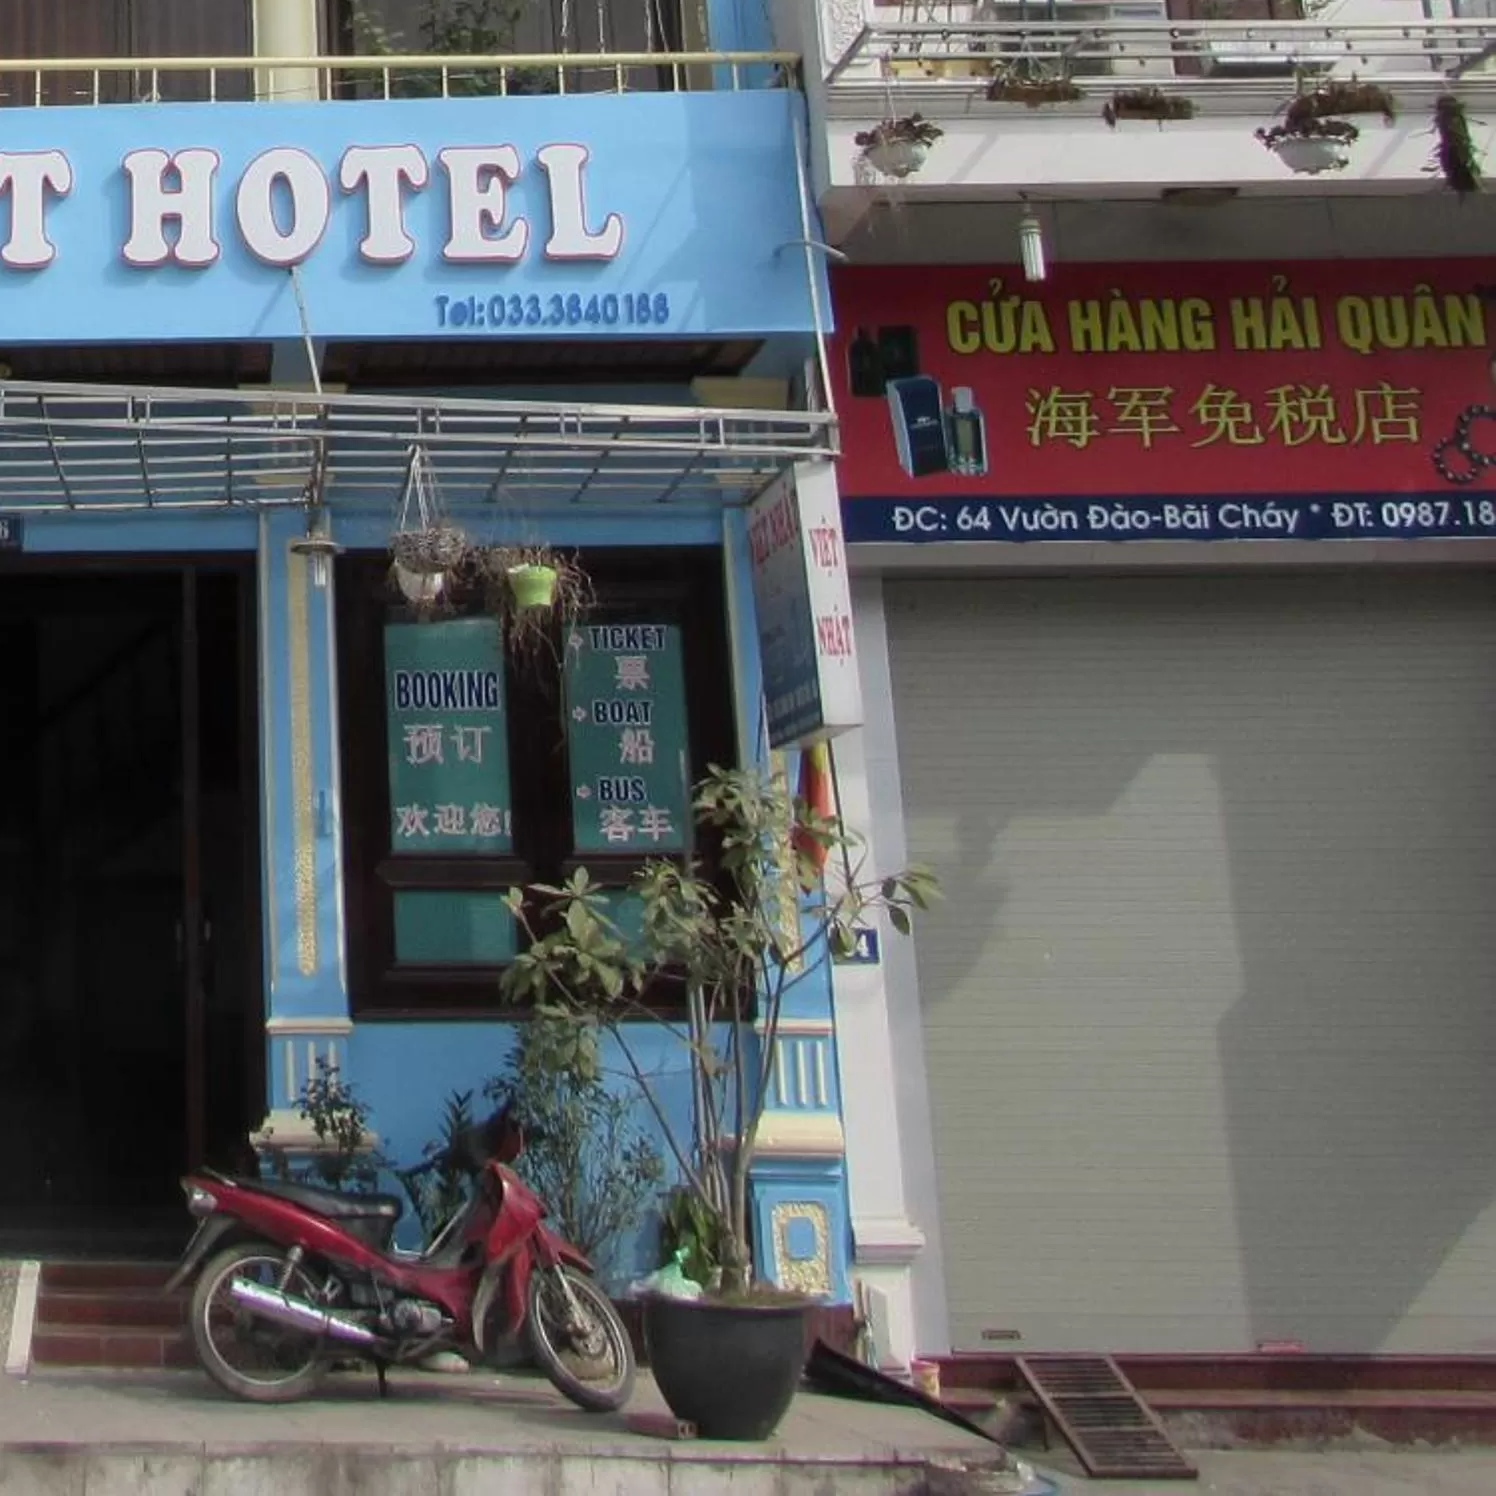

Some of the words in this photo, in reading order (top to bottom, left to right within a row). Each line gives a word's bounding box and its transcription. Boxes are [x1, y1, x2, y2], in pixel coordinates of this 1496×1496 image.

[121, 143, 625, 268] HOTEL
[946, 277, 1054, 354] CỬA
[1067, 287, 1217, 352] HÀNG
[1230, 274, 1322, 350] HẢI
[1336, 284, 1487, 355] QUÂN
[1024, 381, 1422, 448] 海军免税店
[892, 505, 947, 532] ĐC:
[956, 505, 992, 531] 64
[1218, 501, 1300, 534] Cháy
[589, 625, 668, 651] TICKET
[395, 670, 500, 710] BOOKING
[615, 655, 650, 690] 票
[593, 700, 654, 725] BOAT
[402, 723, 493, 765] 预订
[618, 728, 655, 765] 船
[598, 777, 648, 803] BUS
[600, 805, 674, 842] 客车
